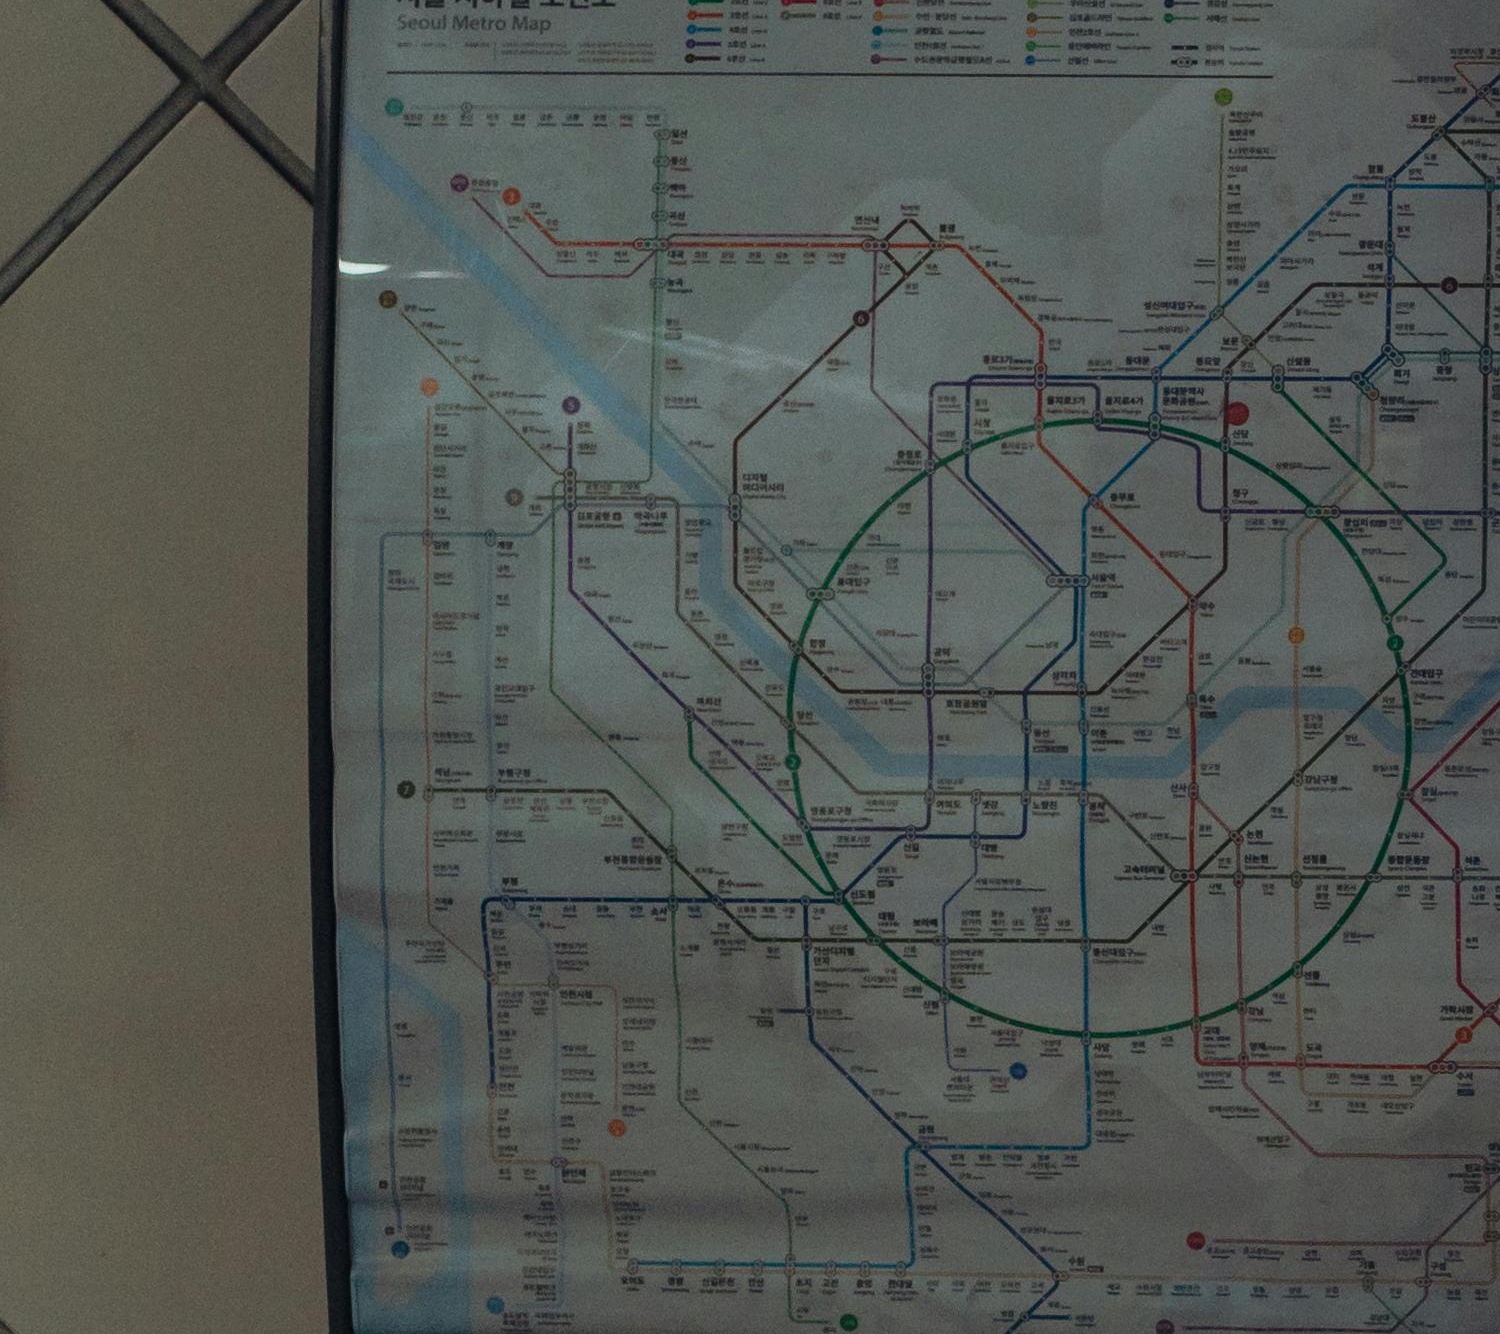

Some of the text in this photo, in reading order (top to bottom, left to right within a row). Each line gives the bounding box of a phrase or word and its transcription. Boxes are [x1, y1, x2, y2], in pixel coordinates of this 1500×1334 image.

[398, 15, 552, 34] Seoul Metro Map
